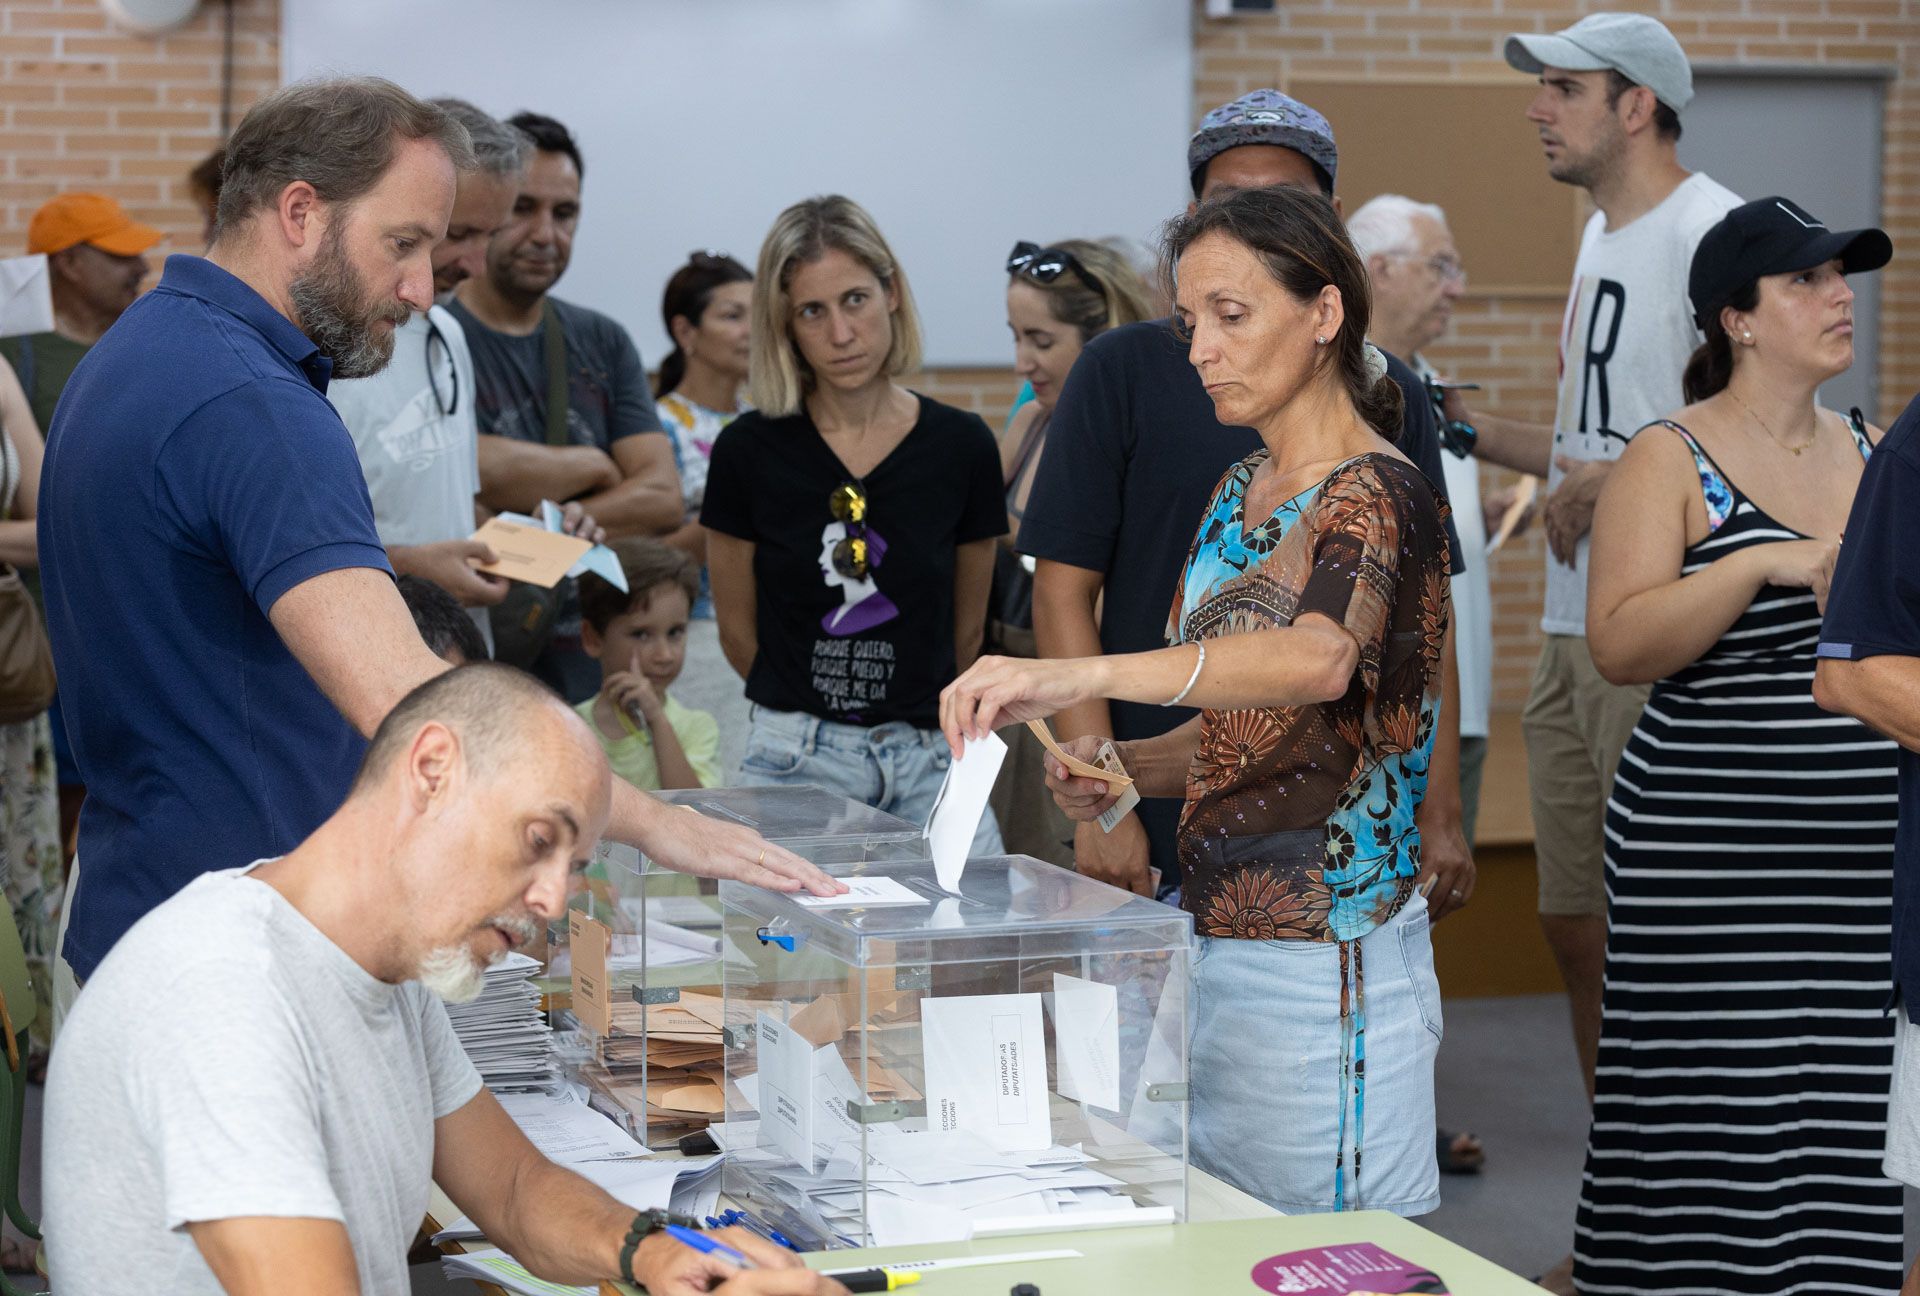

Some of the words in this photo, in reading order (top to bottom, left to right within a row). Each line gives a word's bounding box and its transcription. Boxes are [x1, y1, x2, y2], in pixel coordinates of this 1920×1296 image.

[811, 655, 848, 678] PORQUE
[851, 659, 884, 680] PUEDO
[887, 662, 896, 681] Y
[813, 674, 849, 698] PORQUE
[852, 679, 867, 699] ME
[870, 682, 887, 700] DA
[1000, 1043, 1009, 1097] DIPUTADOAS
